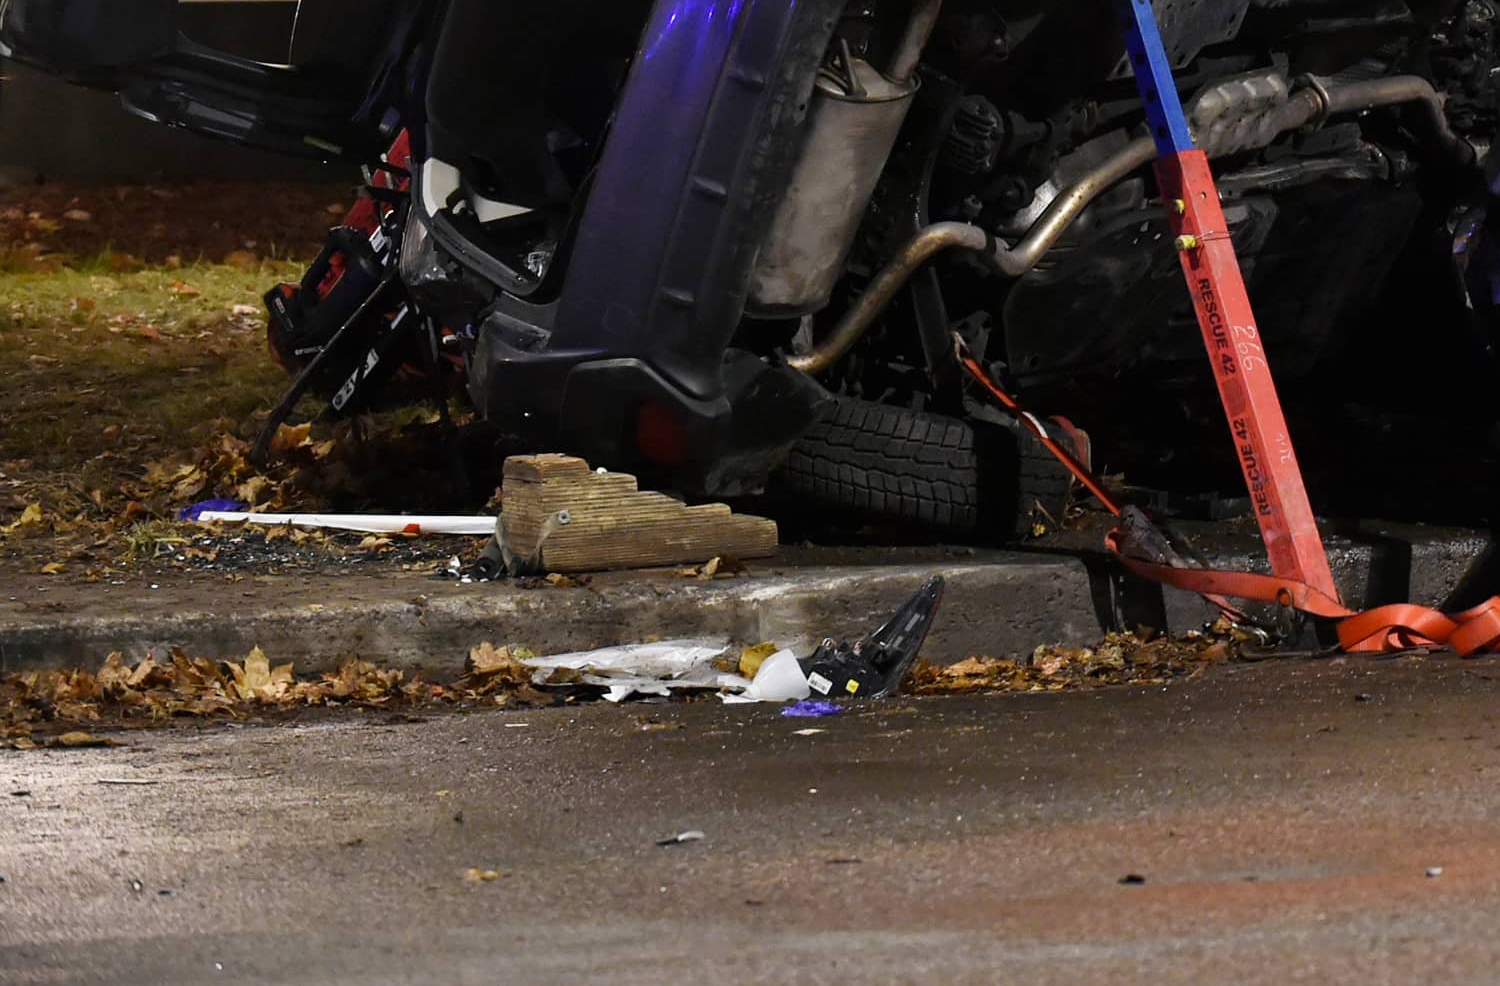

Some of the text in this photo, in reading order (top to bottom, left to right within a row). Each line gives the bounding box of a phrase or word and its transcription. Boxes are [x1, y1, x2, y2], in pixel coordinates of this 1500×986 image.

[1198, 277, 1236, 375] RESCUE 42
[1233, 325, 1266, 372] 266
[1232, 418, 1272, 515] RESCUE 42
